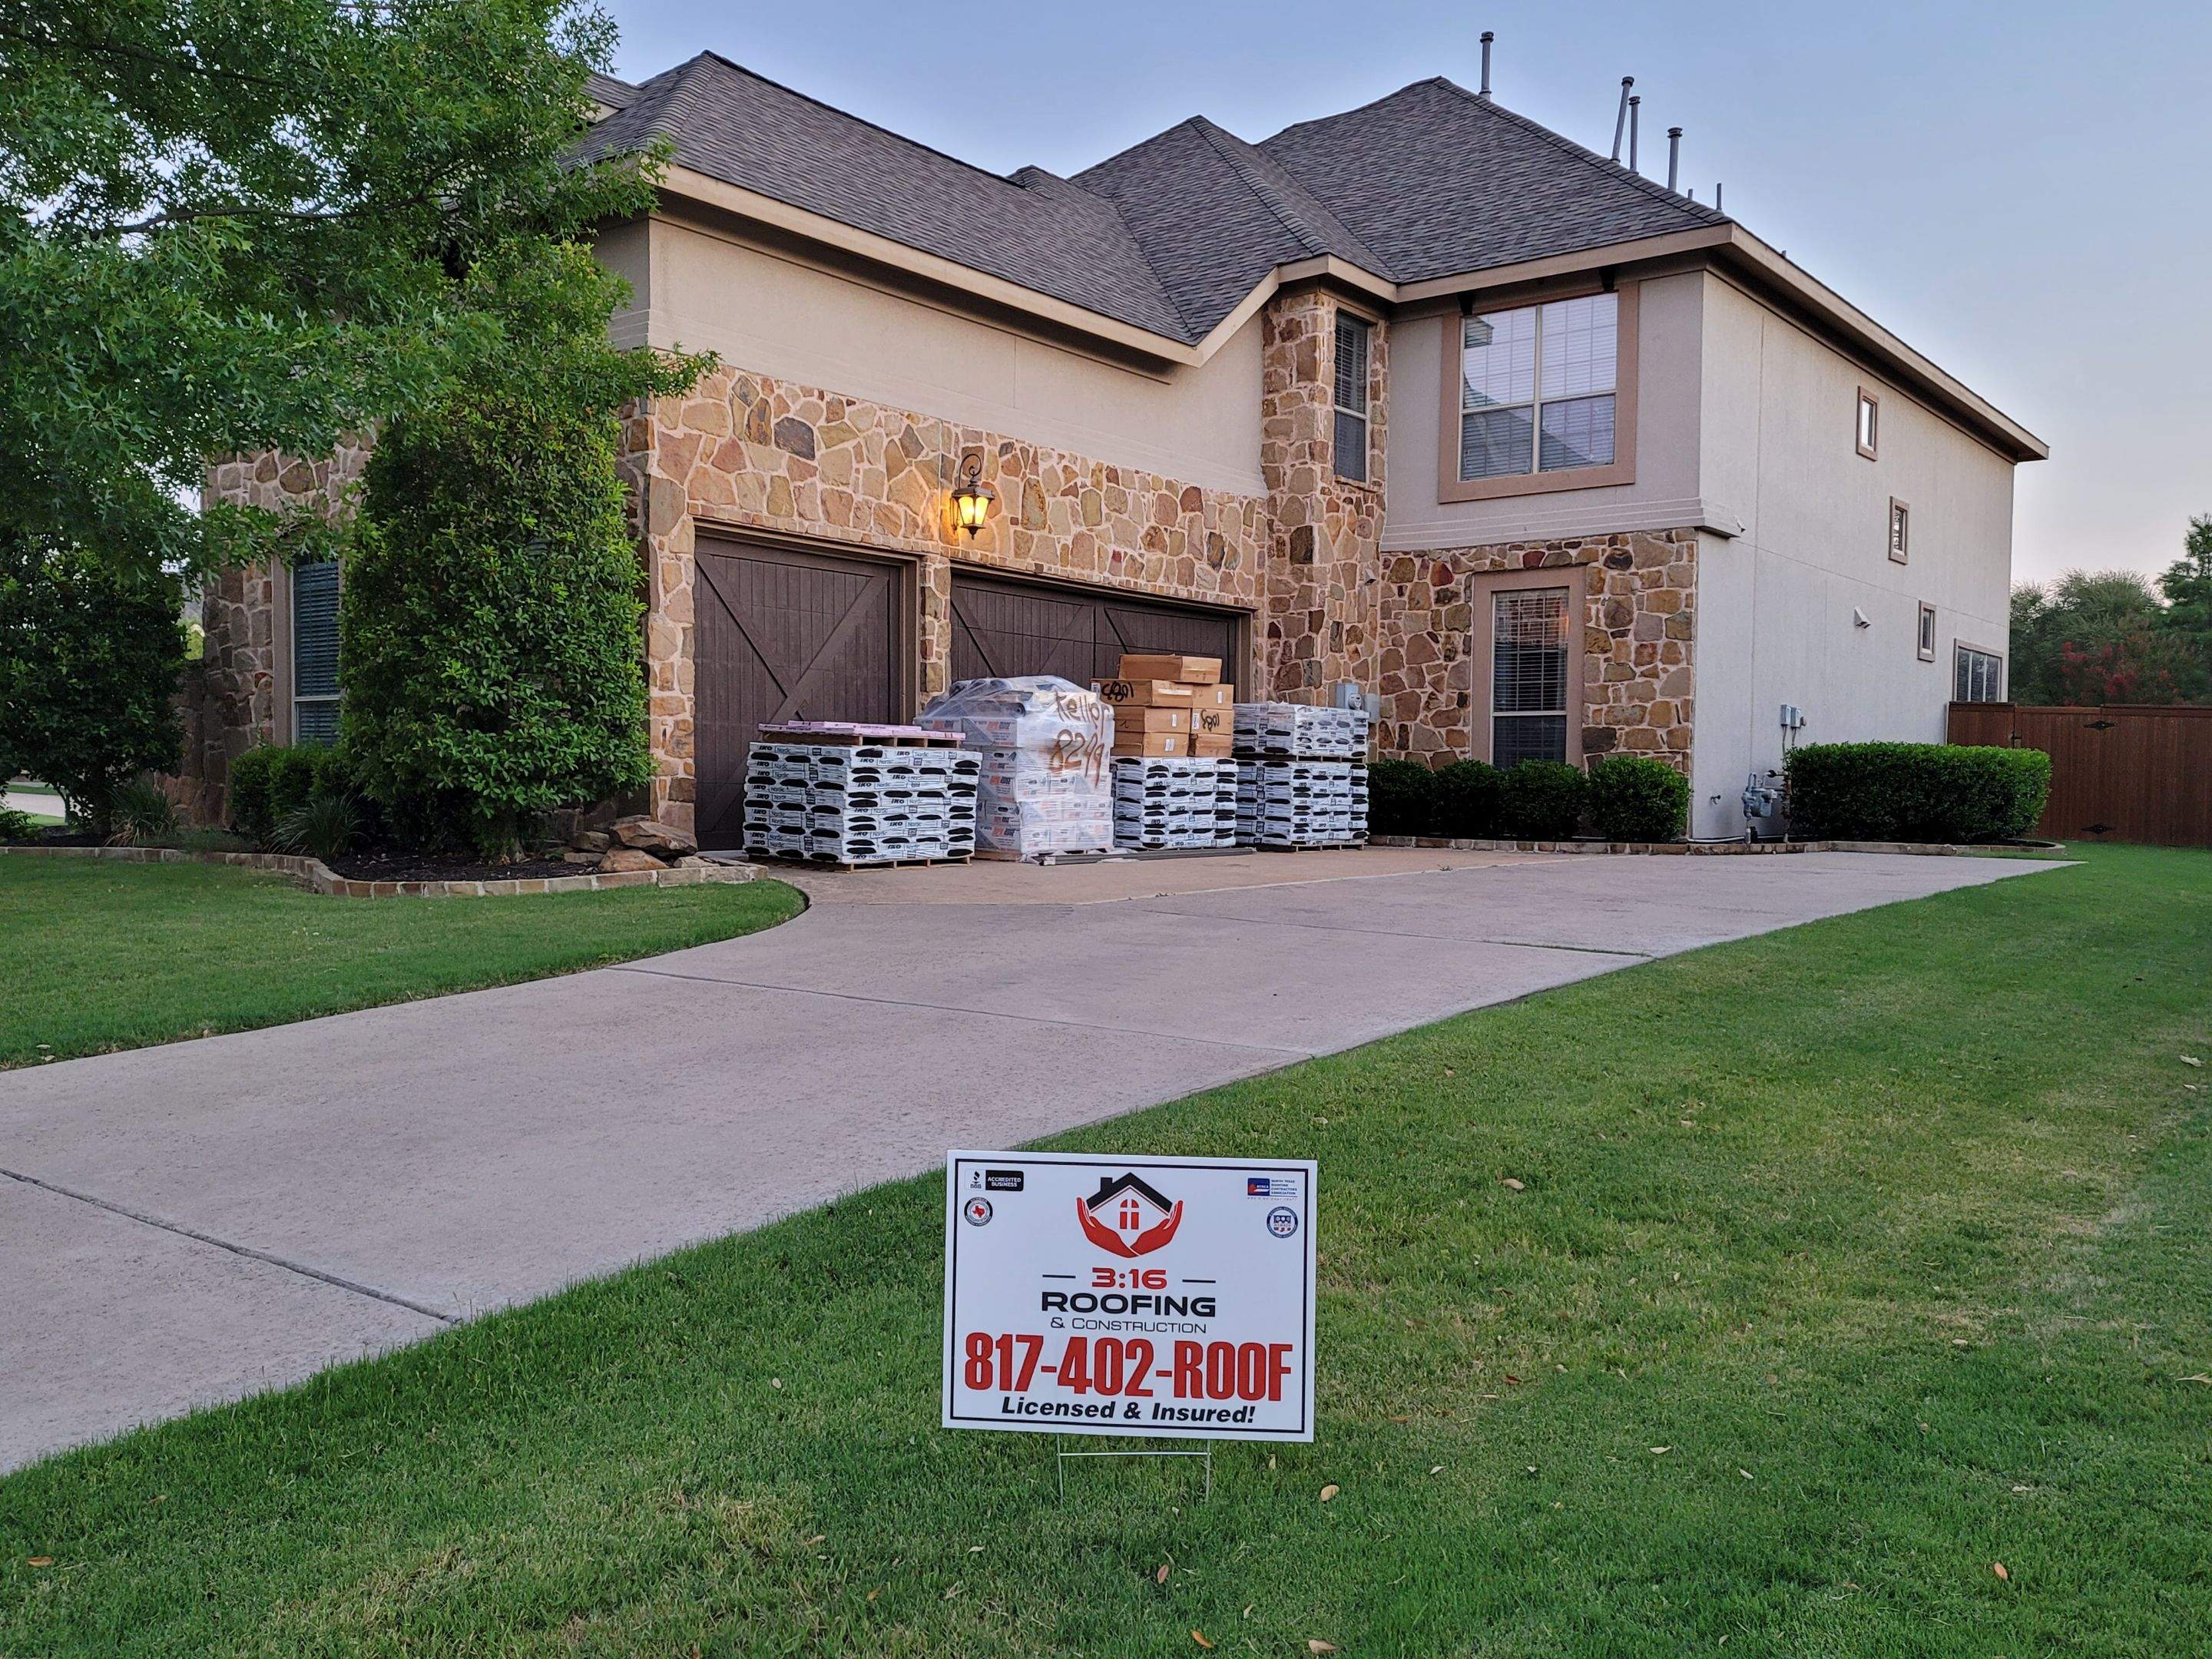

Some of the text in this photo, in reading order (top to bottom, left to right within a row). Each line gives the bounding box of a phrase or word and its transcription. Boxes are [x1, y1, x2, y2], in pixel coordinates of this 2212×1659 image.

[1091, 1267, 1167, 1290] 3:16
[1041, 1291, 1216, 1317] ROOFING
[1051, 1316, 1207, 1333] & CONSTRUCTION
[965, 1332, 1293, 1402] 817-402-ROOF
[1002, 1396, 1256, 1423] Licensed & Insured!
